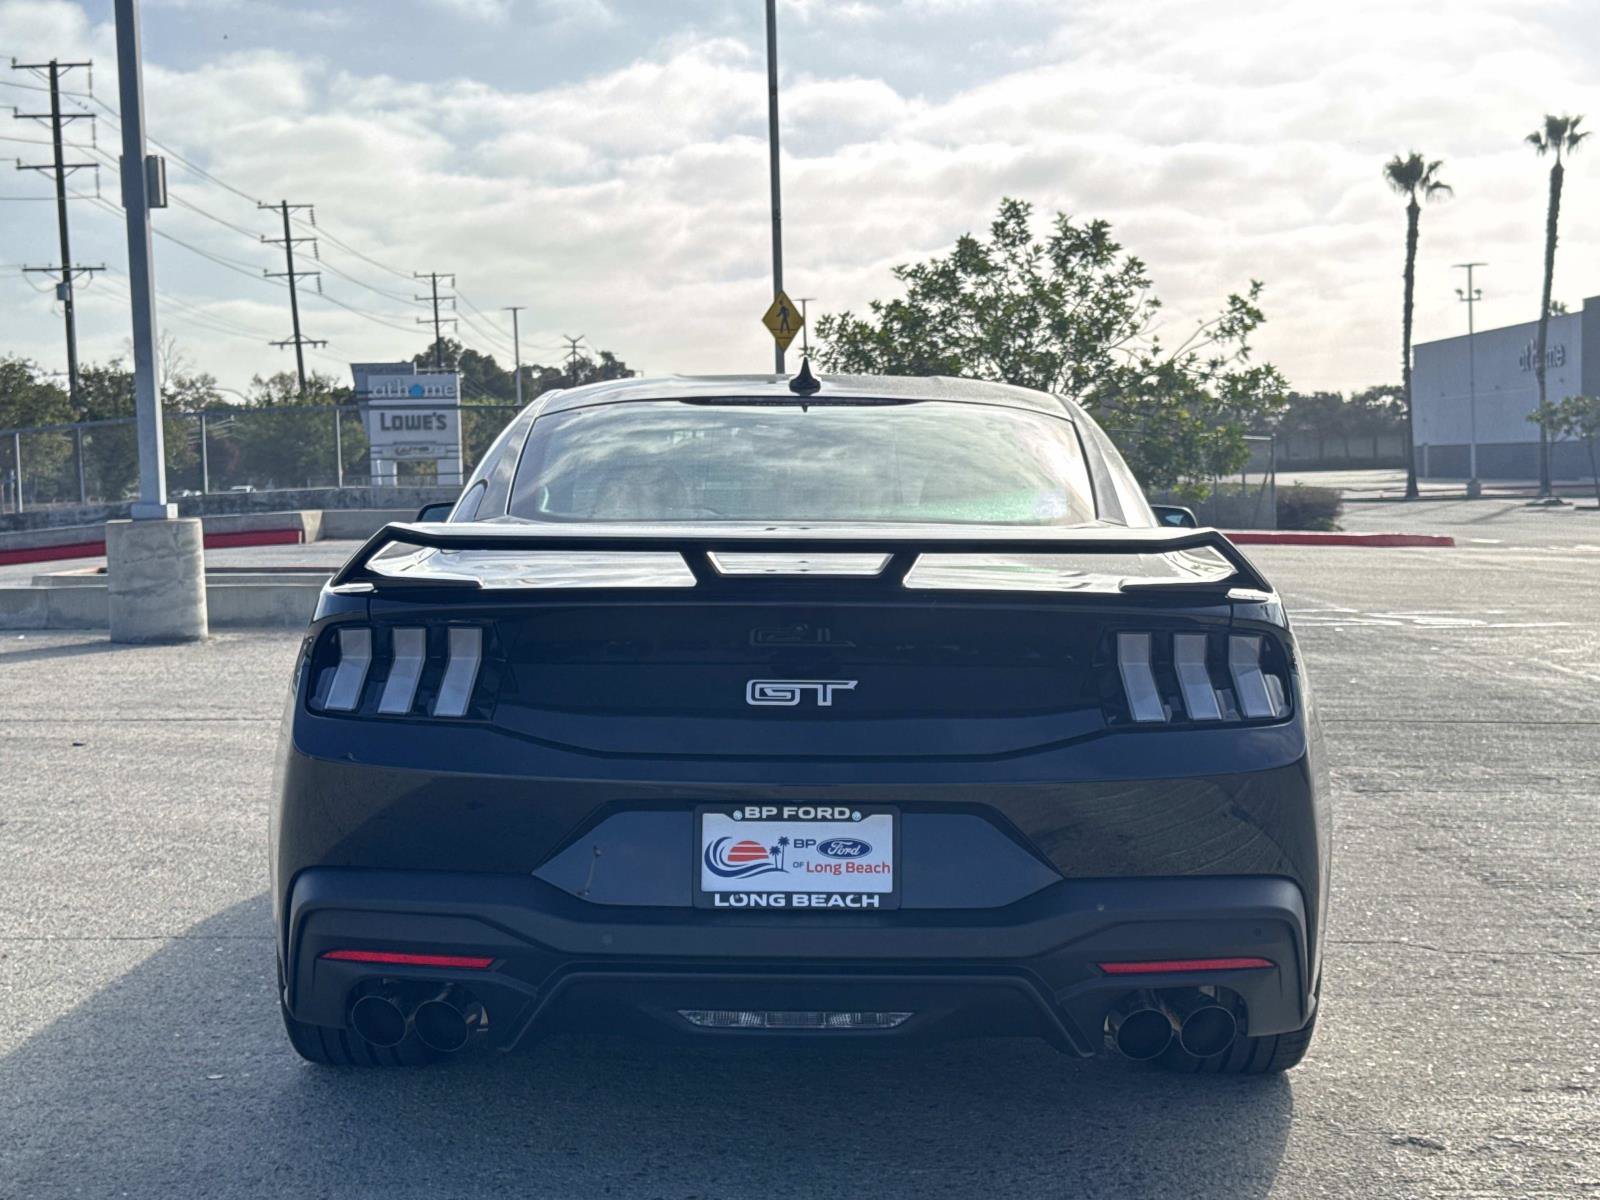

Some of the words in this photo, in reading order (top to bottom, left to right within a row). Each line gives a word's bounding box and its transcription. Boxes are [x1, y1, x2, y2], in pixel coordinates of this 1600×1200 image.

[380, 411, 447, 431] LOWE'S
[746, 679, 858, 706] GT
[744, 806, 779, 819] BP
[783, 806, 850, 820] FORD
[793, 838, 817, 849] BP
[827, 840, 862, 856] Ford
[806, 861, 842, 875] Long
[845, 861, 891, 874] Beach
[714, 893, 786, 907] LONG
[792, 894, 880, 908] BEACH
